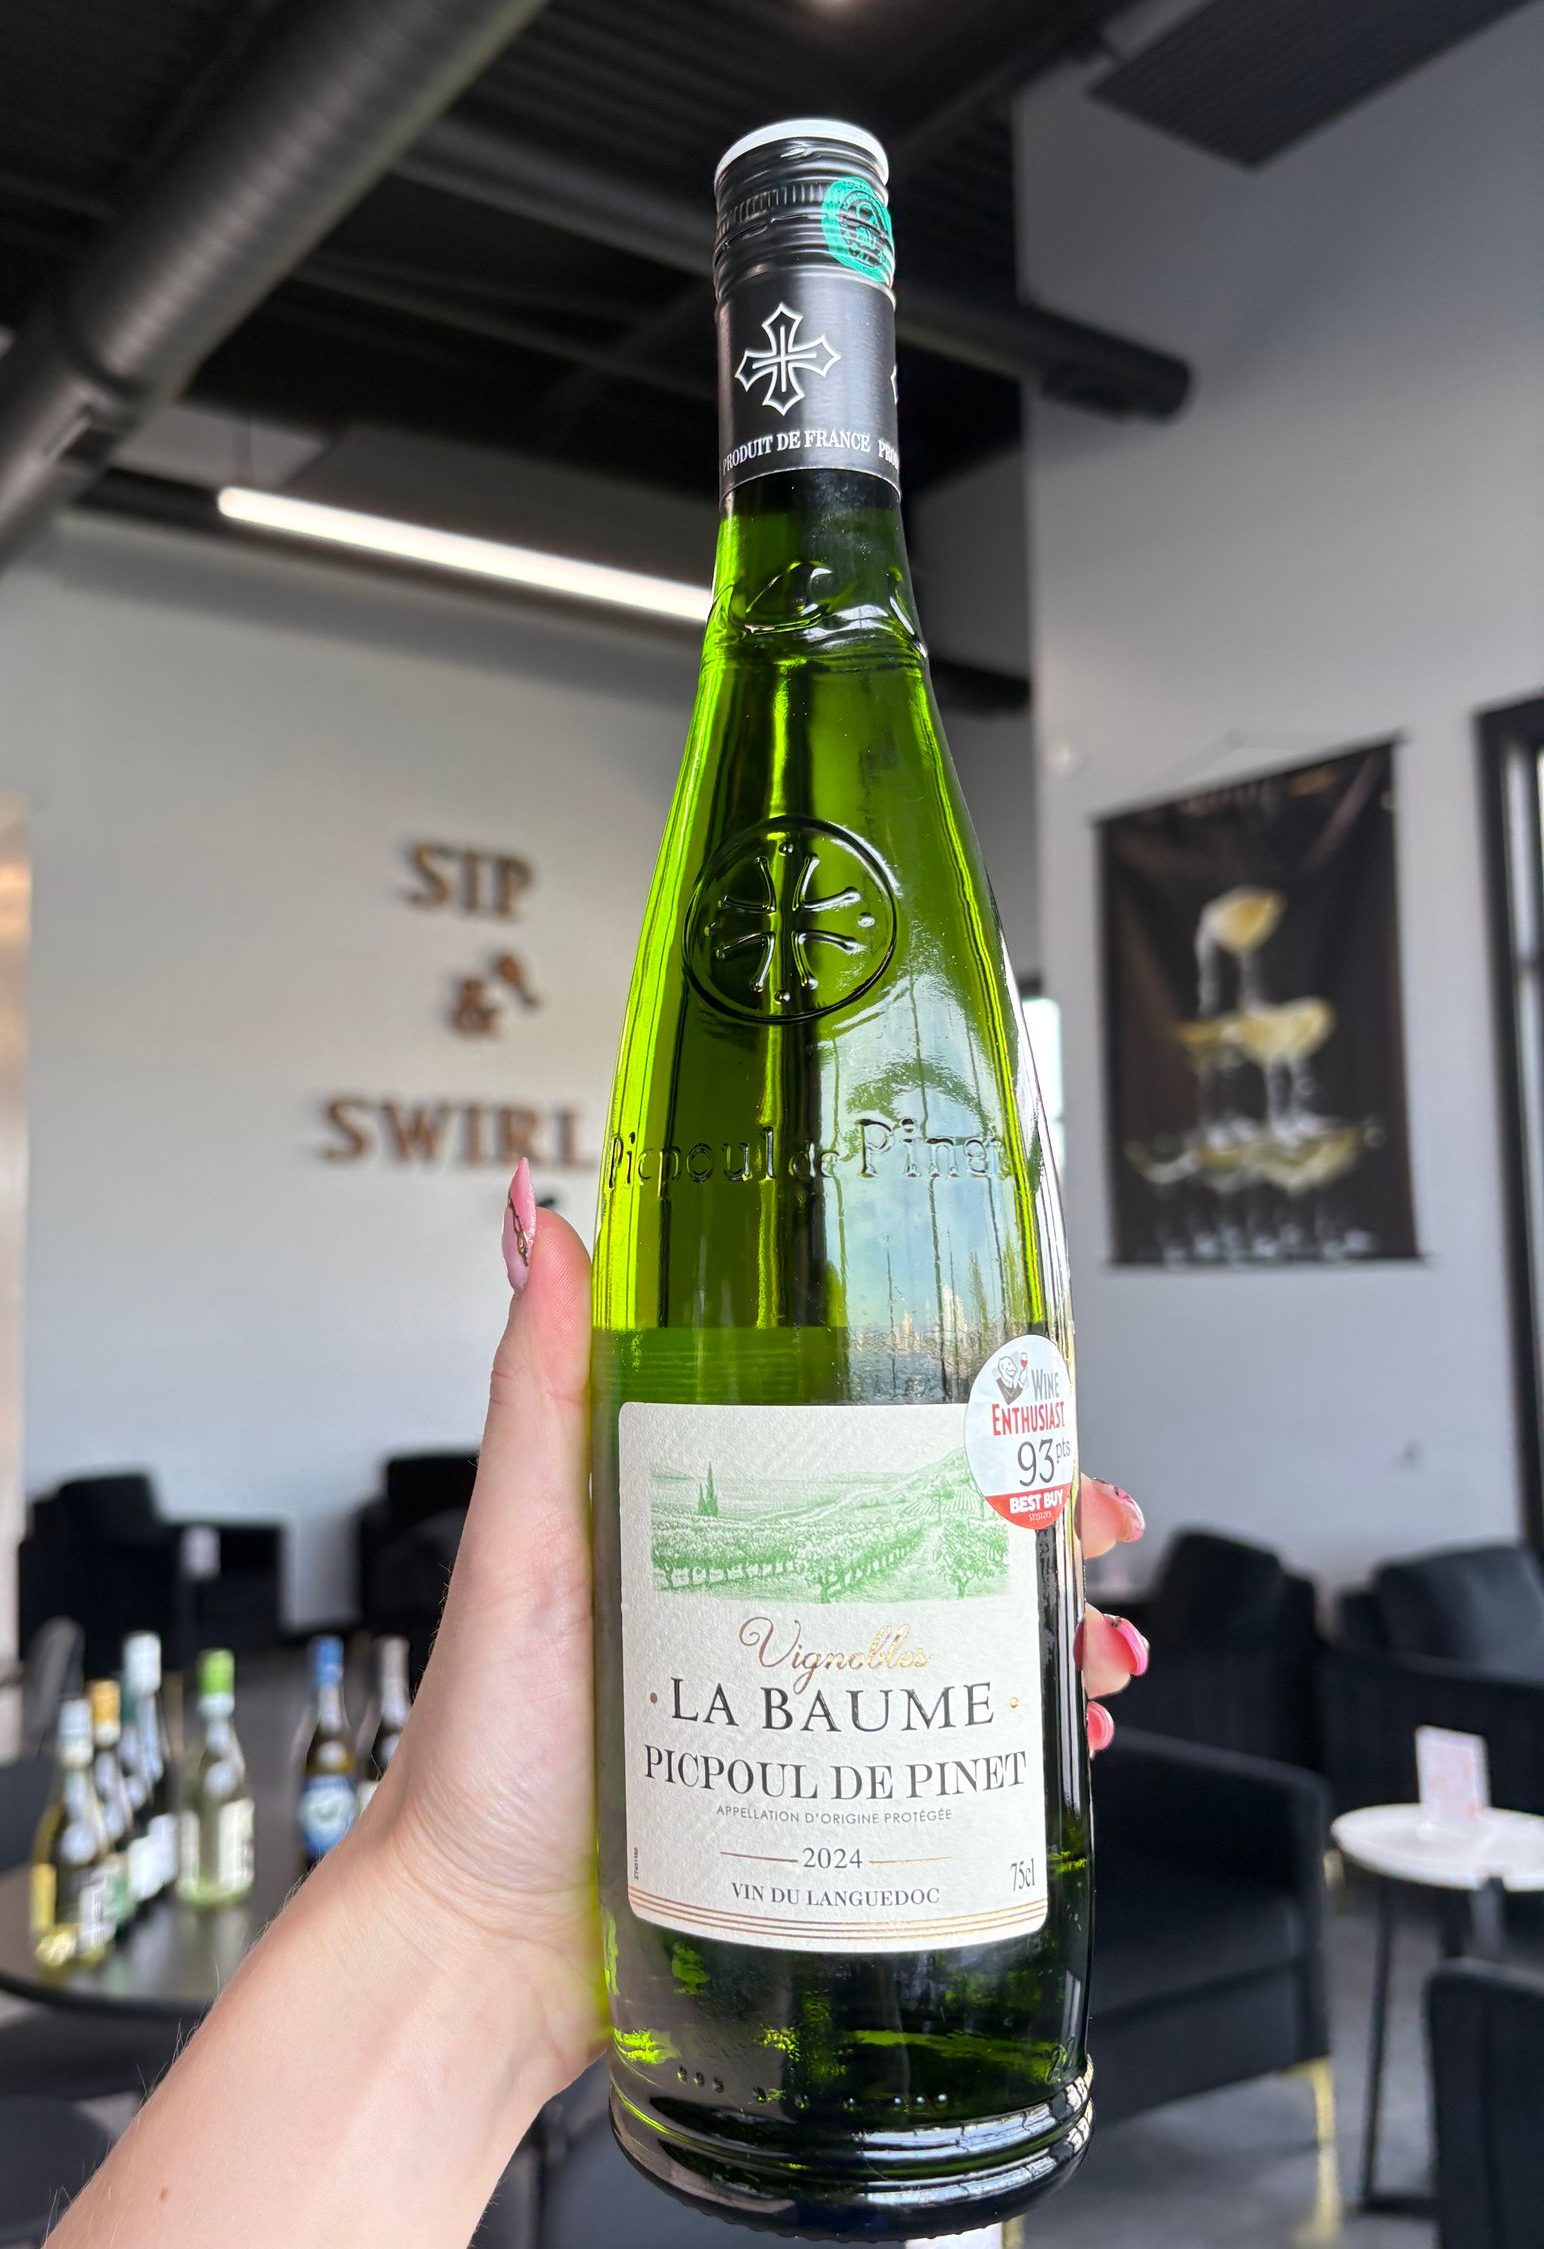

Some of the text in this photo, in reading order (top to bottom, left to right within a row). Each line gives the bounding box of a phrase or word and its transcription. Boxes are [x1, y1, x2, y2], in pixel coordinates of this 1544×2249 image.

[722, 429, 871, 476] PRODUIT DE FRANCE
[402, 842, 536, 920] SIP
[446, 975, 502, 1038] &
[320, 1092, 597, 1170] SWIRL
[1017, 1438, 1055, 1487] 93
[1009, 1488, 1064, 1514] BEST BUY
[738, 1616, 930, 1695] Vignobles
[670, 1676, 995, 1733] LA BAUME
[644, 1743, 1027, 1801] PICPOUL DE PINET
[716, 1804, 952, 1825] APPELLATION D'ORIGINE PROTÉGÉE
[801, 1846, 864, 1869] 2024
[1010, 1857, 1036, 1891] 75cl
[731, 1881, 941, 1907] VIN DU LANGUEDOC
